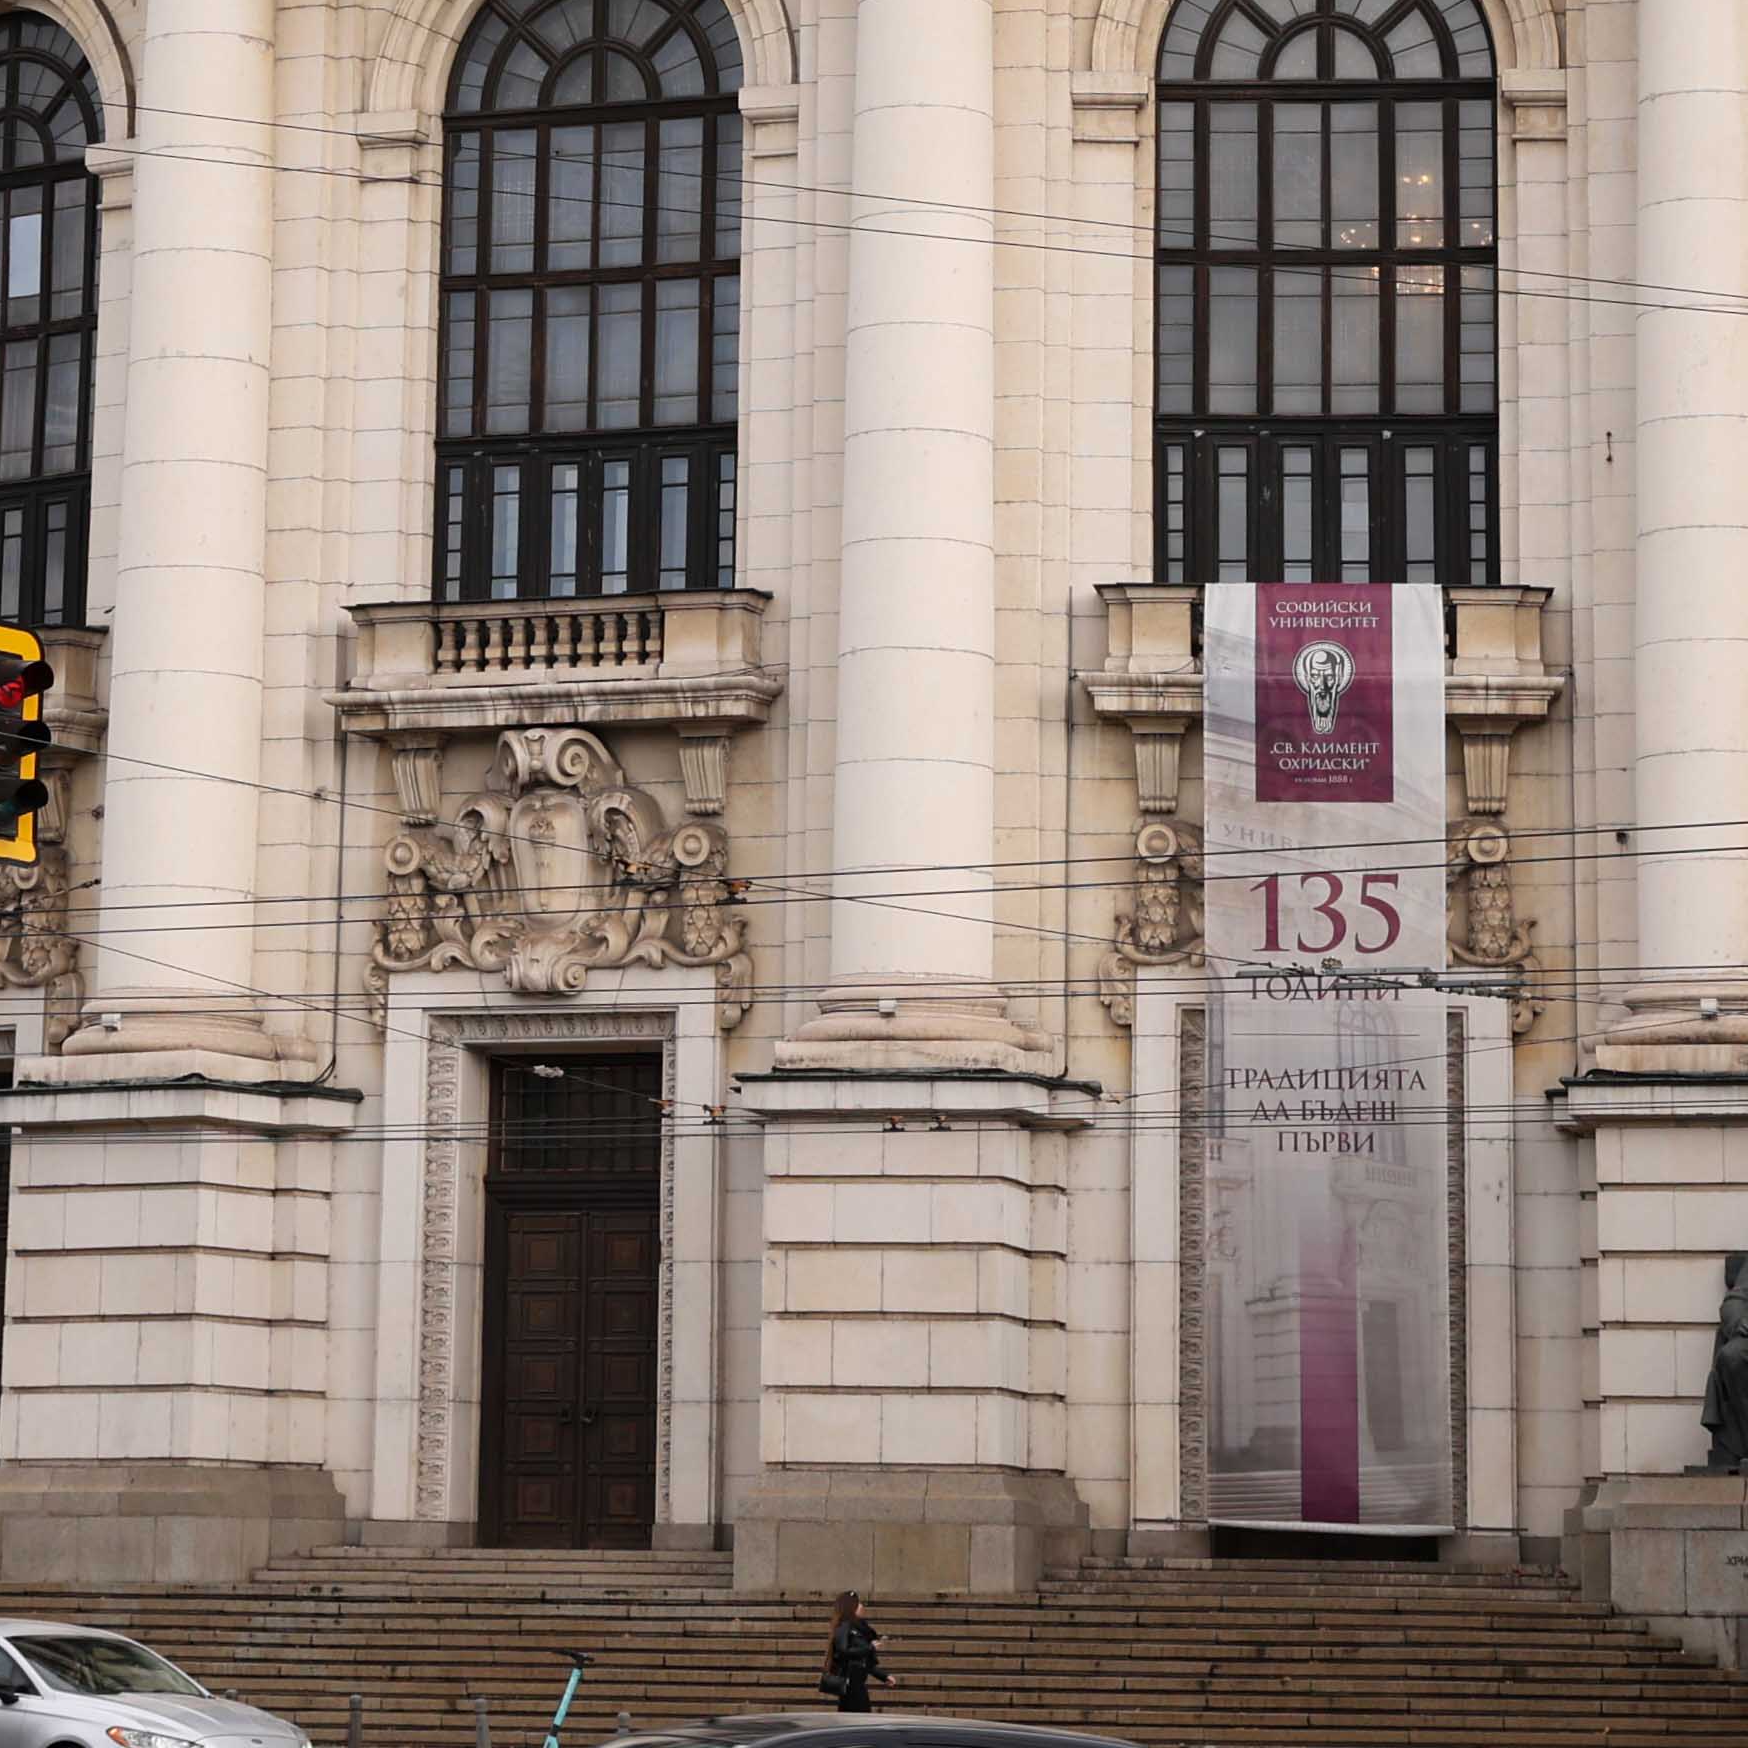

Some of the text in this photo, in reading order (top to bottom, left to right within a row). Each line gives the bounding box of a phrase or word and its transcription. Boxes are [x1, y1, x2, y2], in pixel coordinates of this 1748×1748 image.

[1275, 599, 1372, 614] СОФИЙСКИ
[1269, 616, 1380, 629] УНИВЕРСИТЕТ
[1301, 741, 1380, 755] КЛИМЕНТ
[1249, 870, 1402, 954] 135
[1223, 1067, 1428, 1091] ТРАДИЦИЯТА
[1251, 1099, 1397, 1122] ДА БЪДЕШ
[1278, 1130, 1374, 1153] ПЪРВИ
